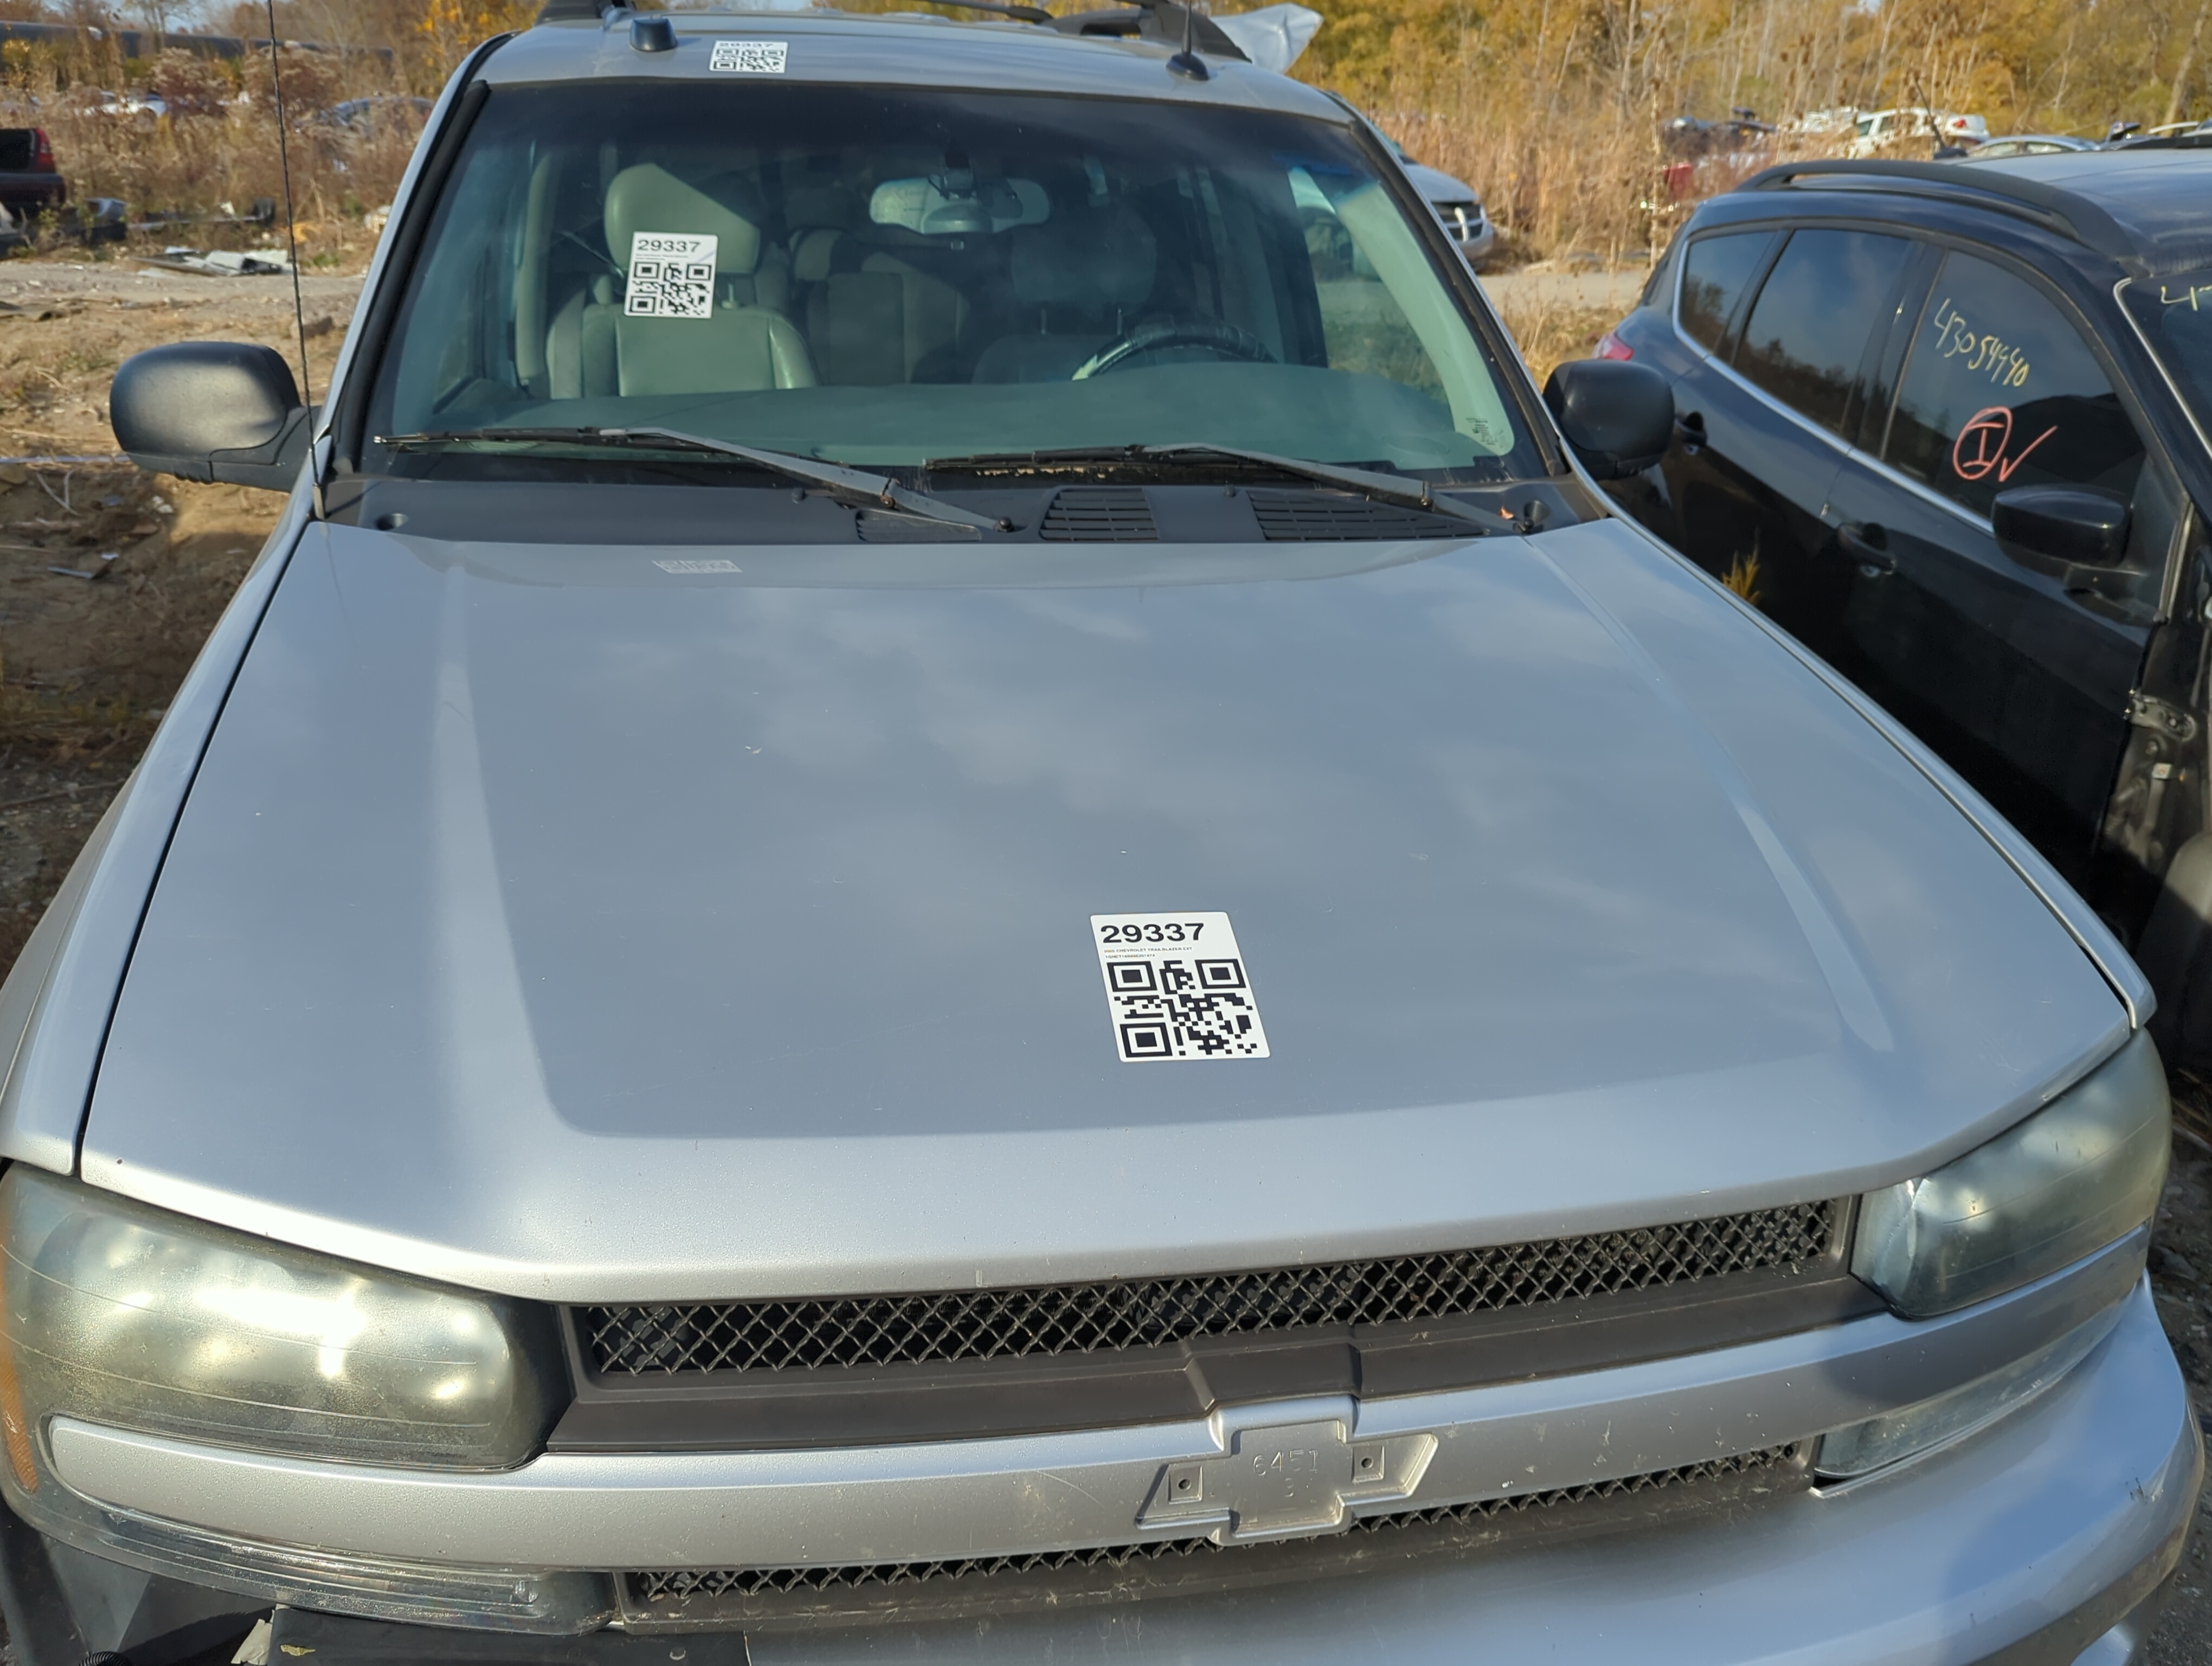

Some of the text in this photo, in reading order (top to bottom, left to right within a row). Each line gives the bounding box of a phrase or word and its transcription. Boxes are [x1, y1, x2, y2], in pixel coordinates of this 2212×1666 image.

[637, 240, 700, 252] 29337
[1101, 923, 1204, 943] 29337
[1253, 1449, 1318, 1476] 6451
